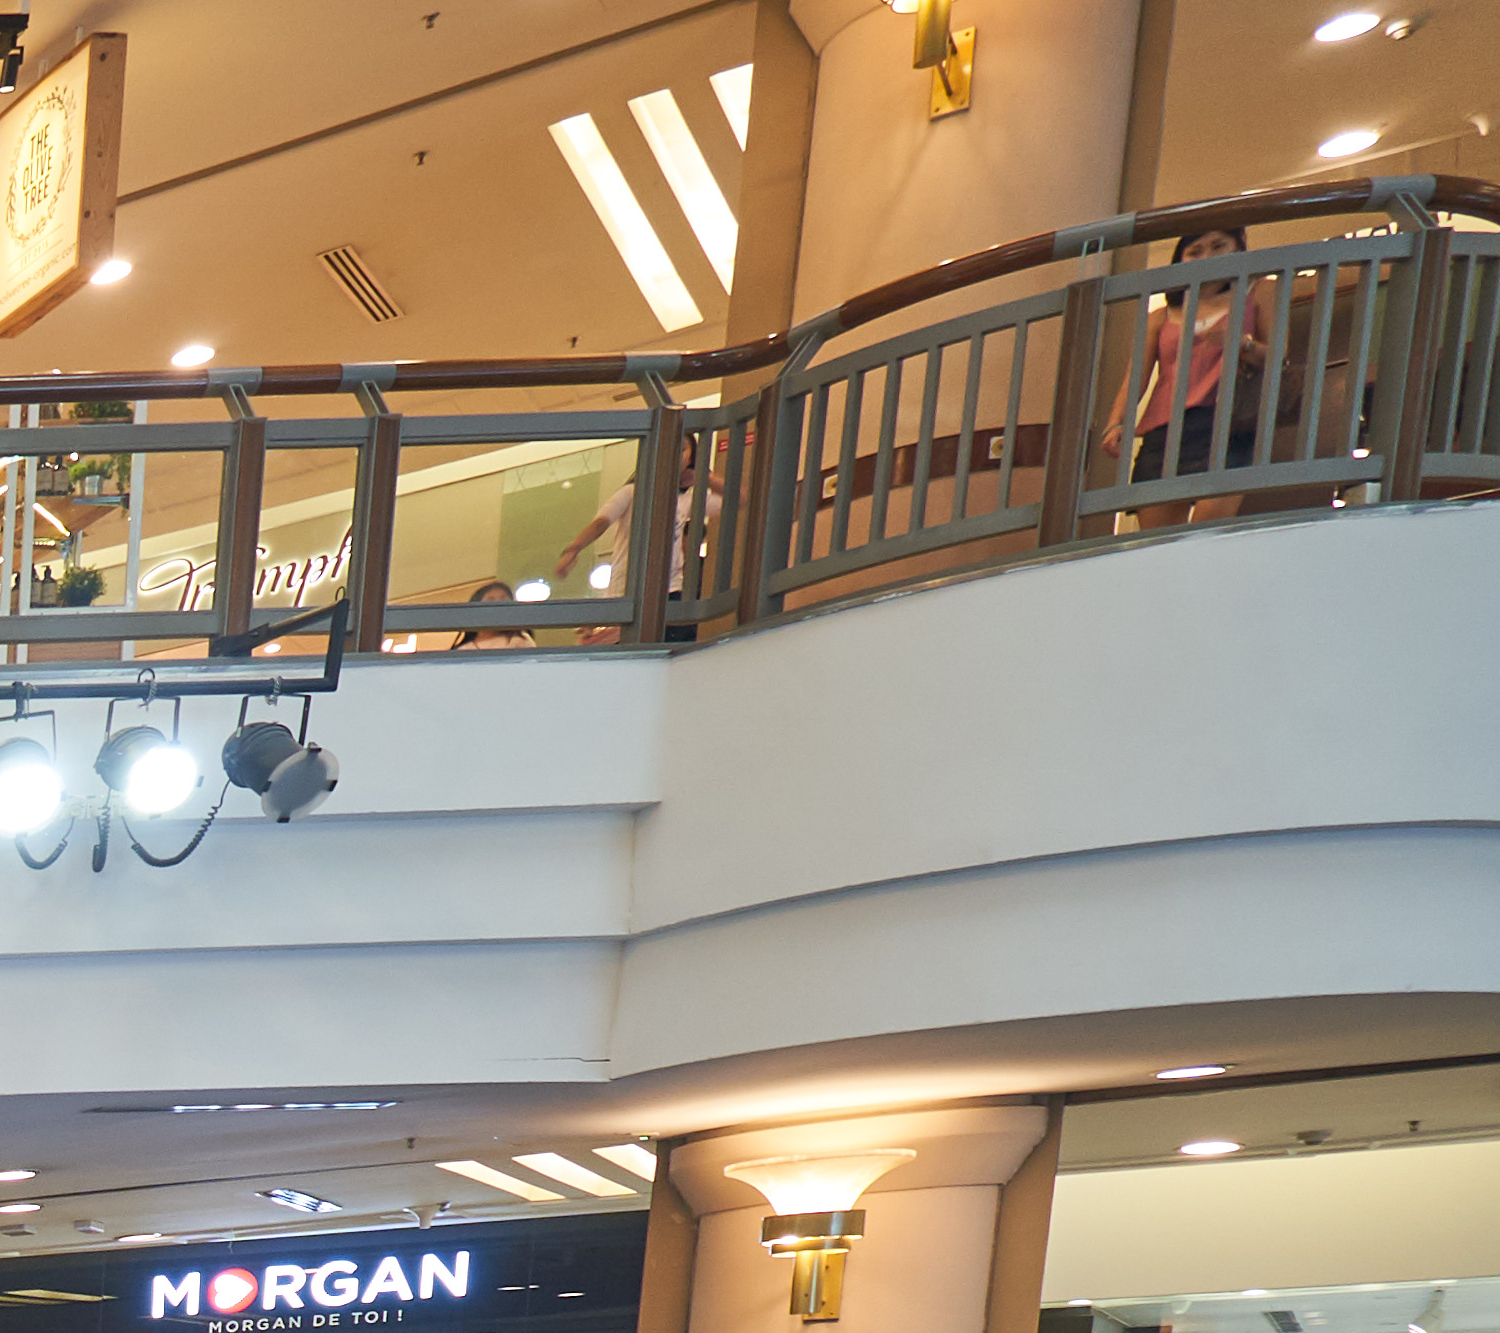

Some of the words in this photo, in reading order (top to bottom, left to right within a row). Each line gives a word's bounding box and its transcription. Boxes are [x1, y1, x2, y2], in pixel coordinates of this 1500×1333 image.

[30, 123, 51, 160] THE
[22, 146, 54, 191] OLIVE
[24, 174, 50, 215] TREE
[151, 1250, 471, 1319] MORGAN
[313, 1312, 341, 1327] DE
[352, 1310, 389, 1325] TOI
